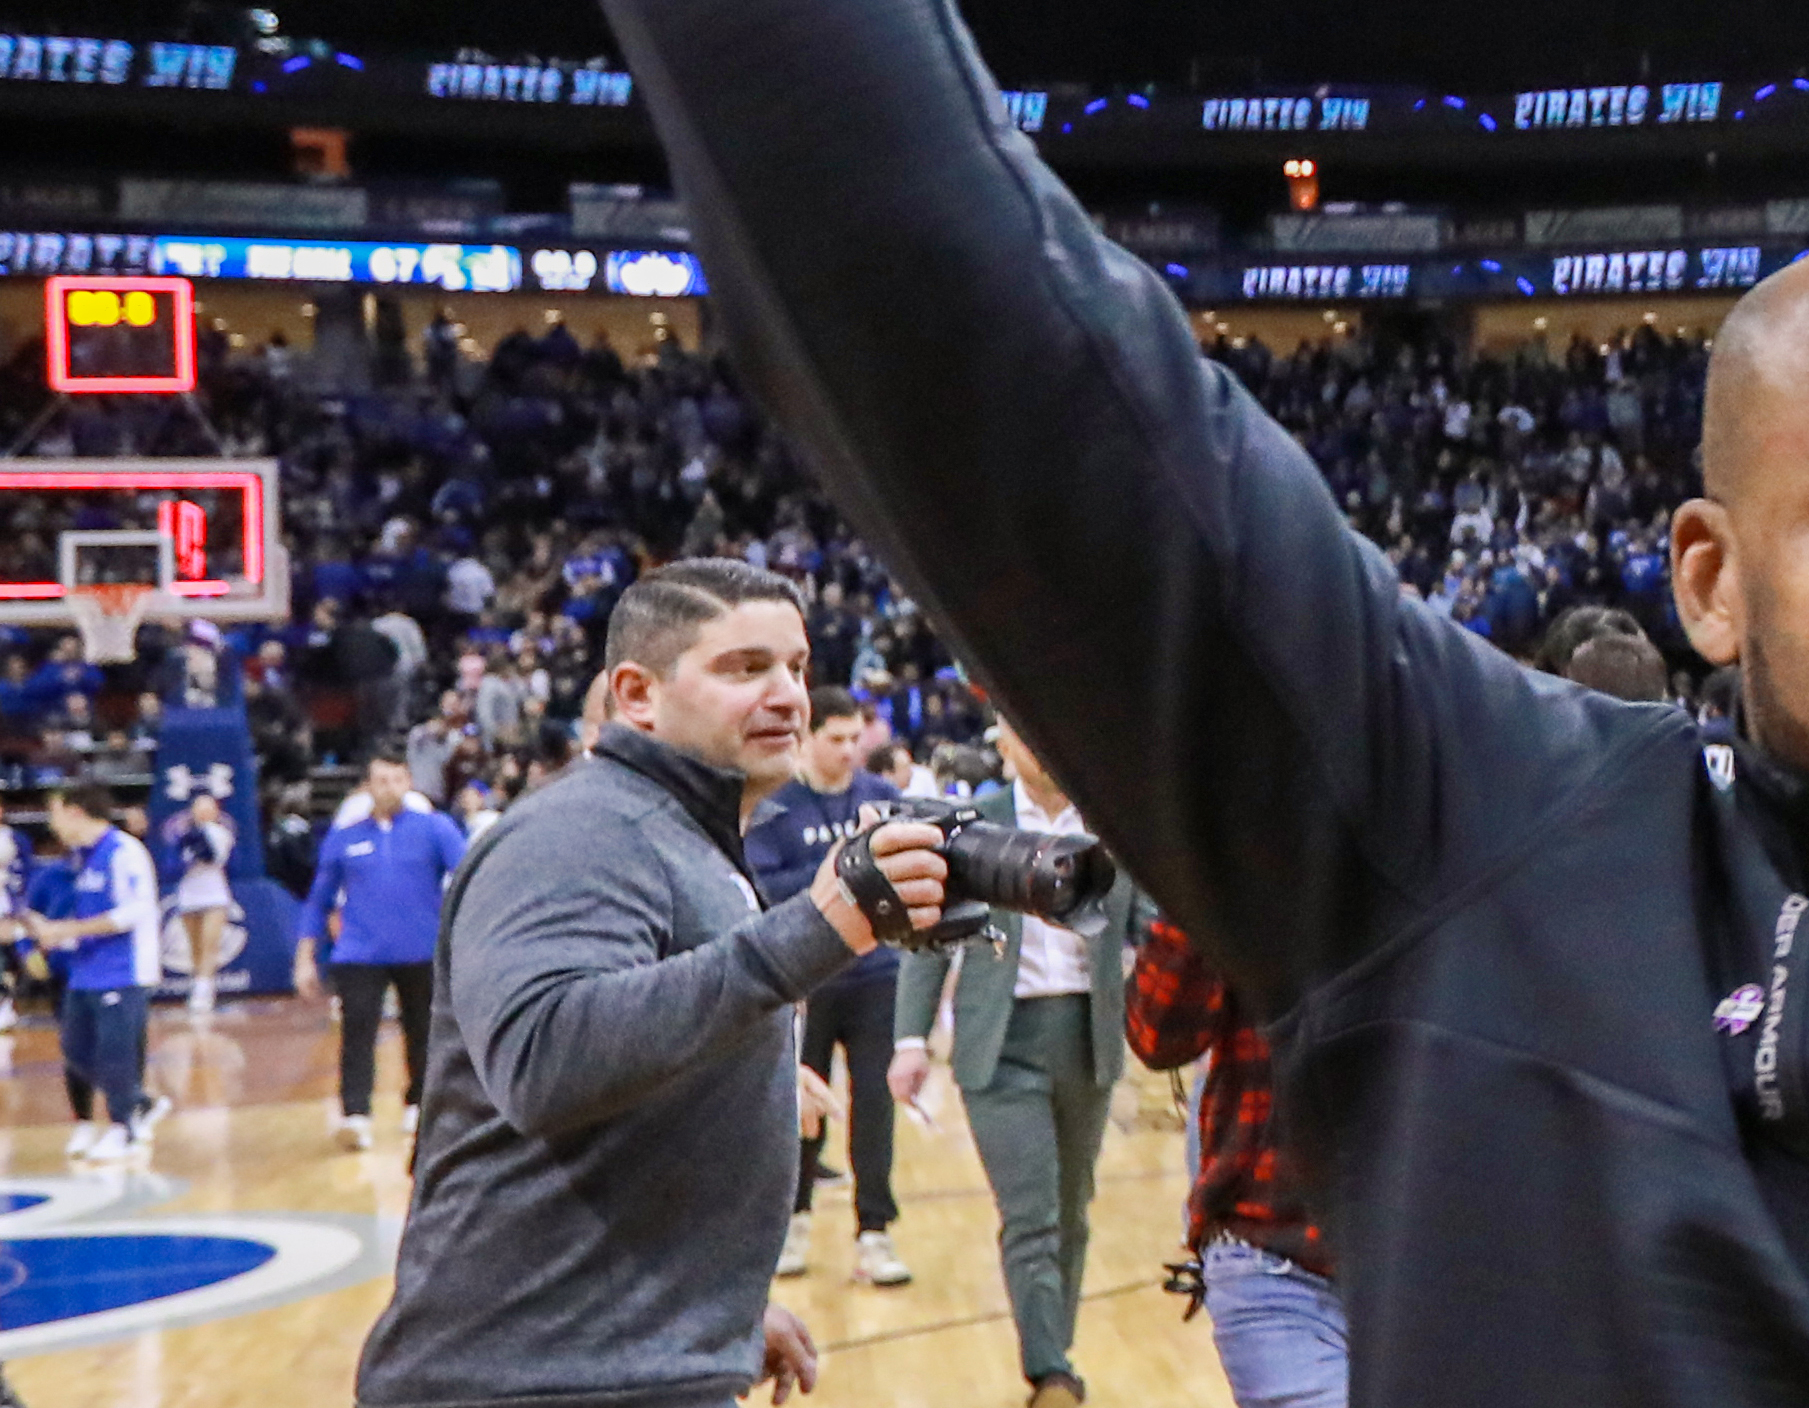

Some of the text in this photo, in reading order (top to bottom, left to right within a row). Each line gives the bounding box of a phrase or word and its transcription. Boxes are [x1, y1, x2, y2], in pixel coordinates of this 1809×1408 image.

[146, 41, 238, 89] WIN
[427, 64, 563, 102] PIRATES
[1202, 97, 1371, 130] PIRATES WIN
[1514, 81, 1723, 129] PIRATES WIN
[1242, 265, 1411, 298] PIRATES WIN
[1552, 246, 1762, 294] PIRATES WIN
[1753, 964, 1790, 1120] ARMOUR
